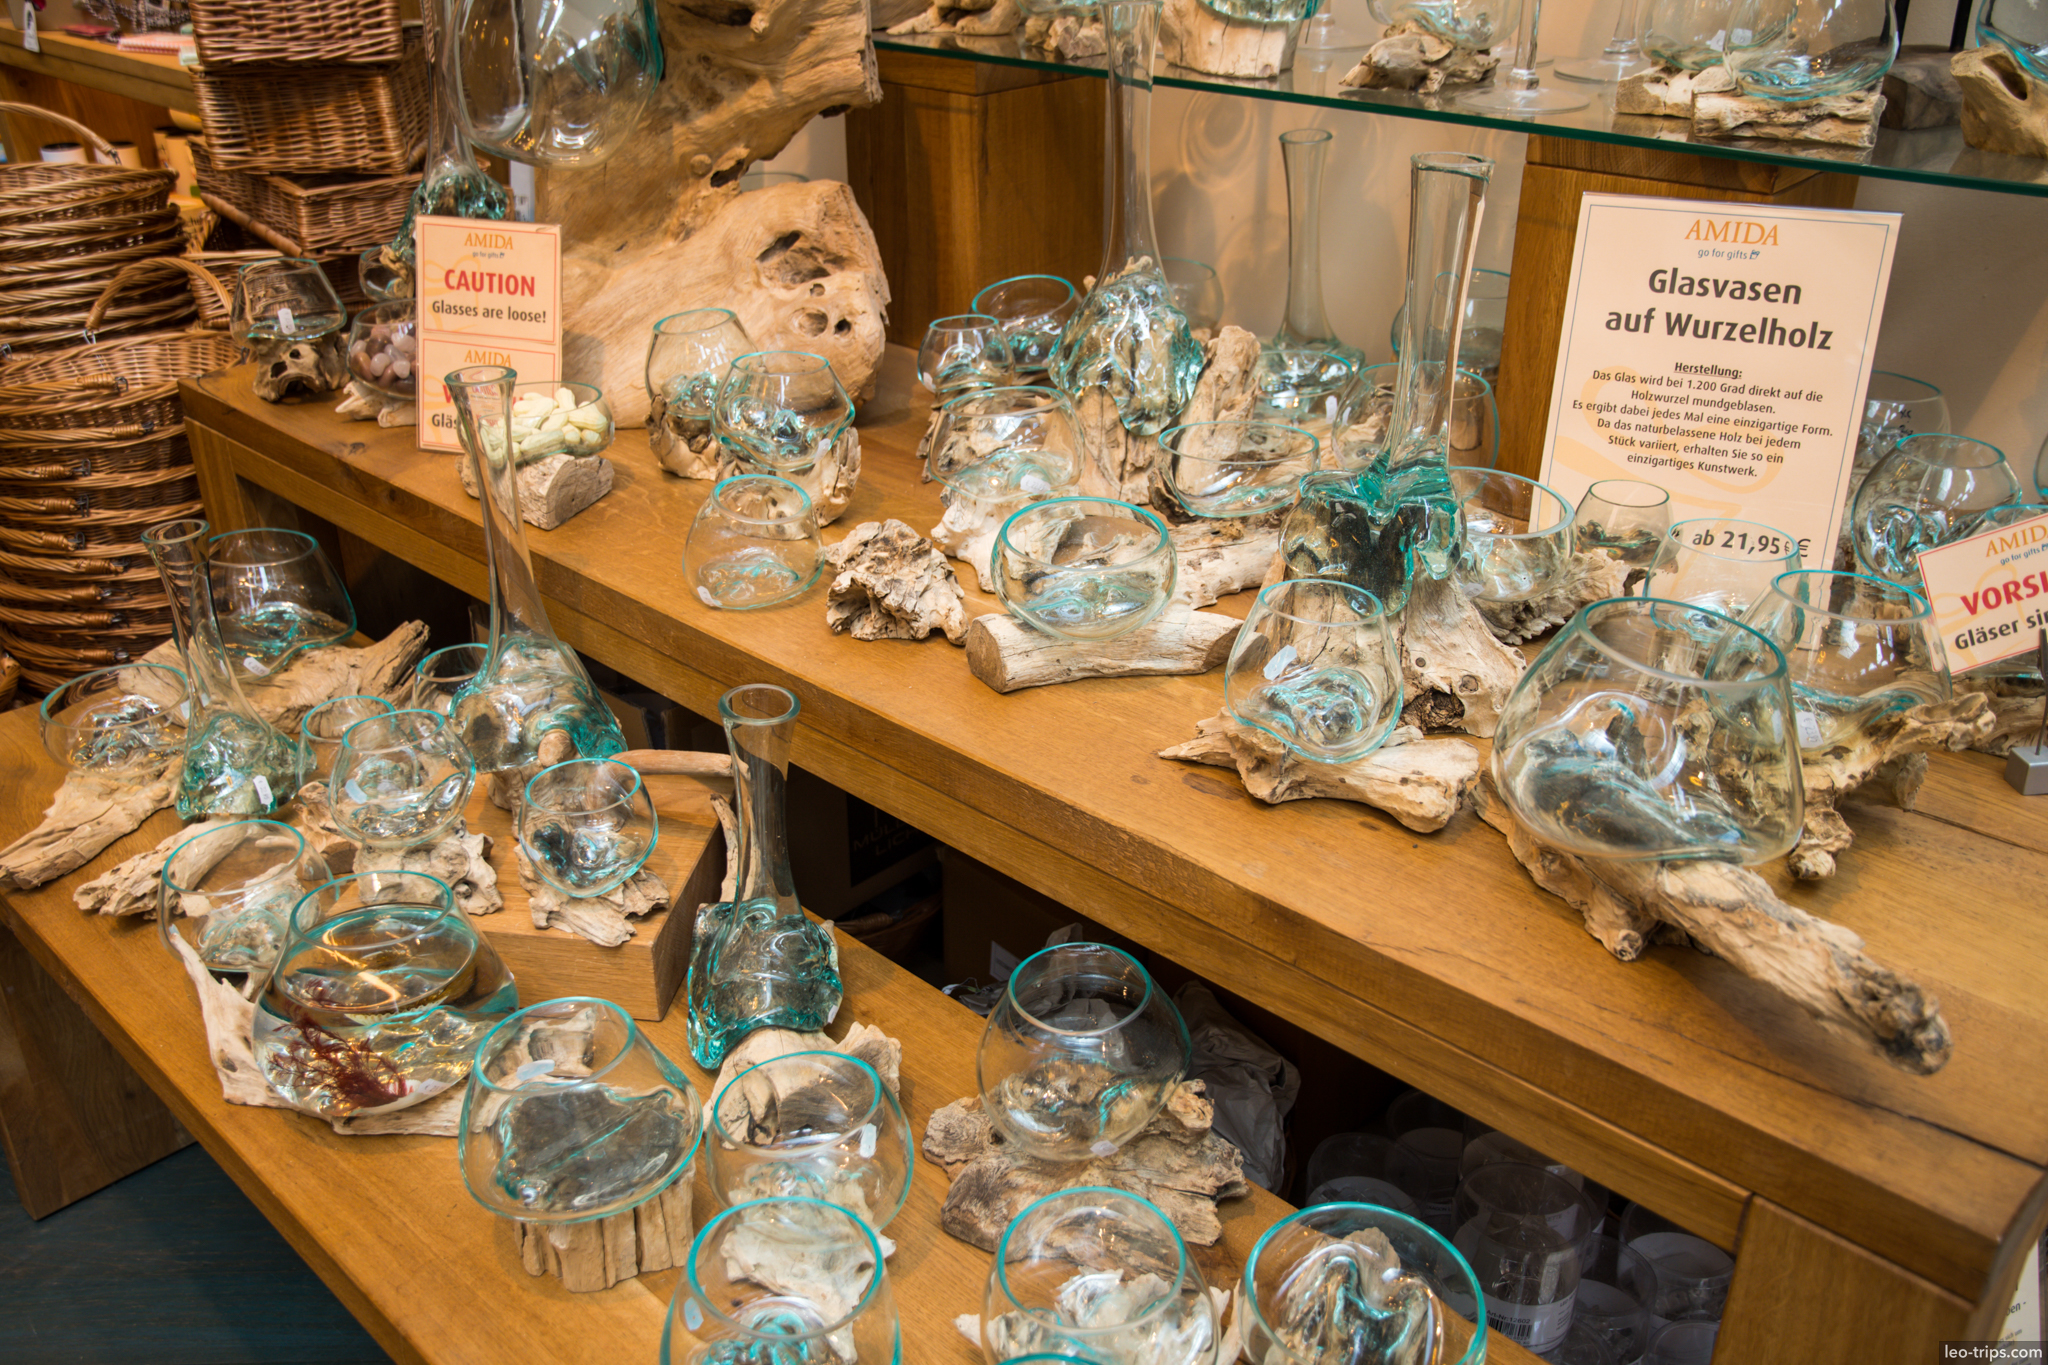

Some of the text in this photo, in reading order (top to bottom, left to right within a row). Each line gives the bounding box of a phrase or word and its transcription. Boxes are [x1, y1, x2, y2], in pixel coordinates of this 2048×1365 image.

[464, 232, 514, 250] AMIDA
[1684, 219, 1779, 246] AMIDA
[1697, 248, 1748, 261] go for gifts
[444, 269, 535, 297] CAUTION
[1649, 267, 1802, 305] Glasvasen
[432, 300, 546, 323] Glasses are loose!
[1605, 307, 1833, 350] auf Wurzelholz
[464, 349, 512, 368] AMIDA
[1674, 362, 1742, 379] Herstellung:
[1592, 370, 1823, 402] Das Glas wird bei 1.200 Grad direkt auf die
[1631, 390, 1776, 414] Holzwurzel mundgeblasen.
[1572, 400, 1833, 436] Es ergibt dabei jedes Mal eine einzigartige Form.
[1597, 418, 1801, 449] Da das naturbelassene Holz bei jedem
[1608, 435, 1784, 464] Stück variiert, erhalten Sie so ein
[1627, 453, 1757, 477] einzigartiges Kunstwerk.
[1692, 529, 1811, 557] ab 21,95 €
[1985, 524, 2048, 558] AMID
[2000, 547, 2040, 566] go for gifts
[1954, 620, 2019, 650] Gläser
